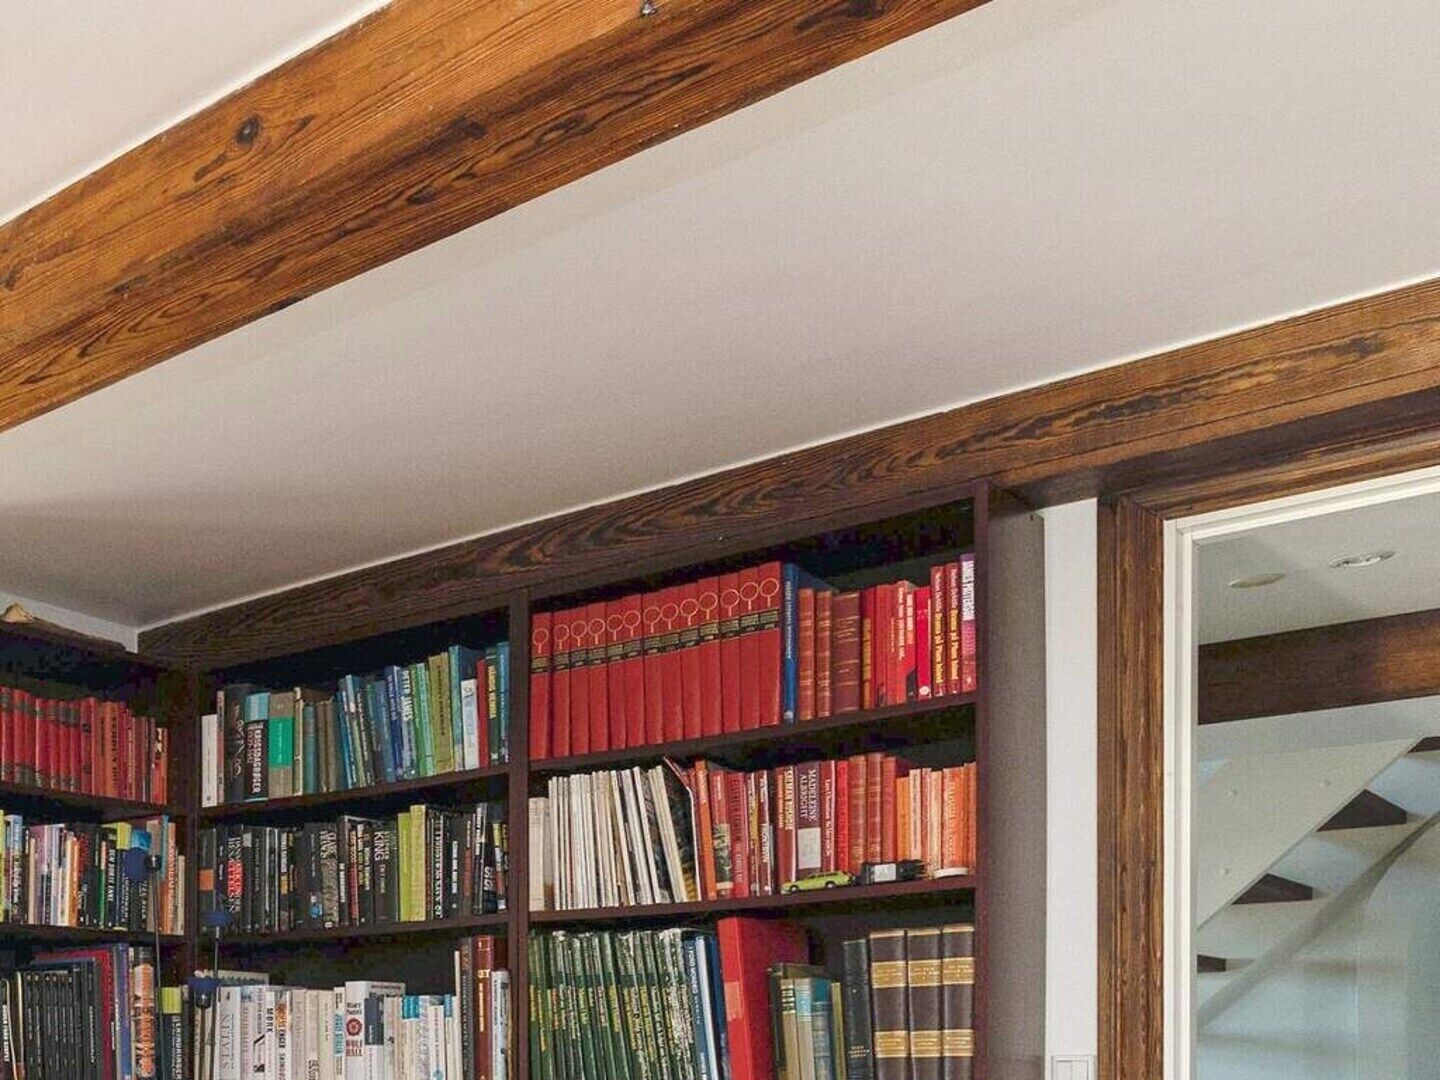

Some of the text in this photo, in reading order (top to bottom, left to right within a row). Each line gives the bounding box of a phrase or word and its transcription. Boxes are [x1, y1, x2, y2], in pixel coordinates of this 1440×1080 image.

[800, 775, 809, 820] ALBRIGHT
[808, 770, 819, 822] MADELEINE
[374, 831, 384, 861] KING
[220, 1013, 230, 1070] STALIN
